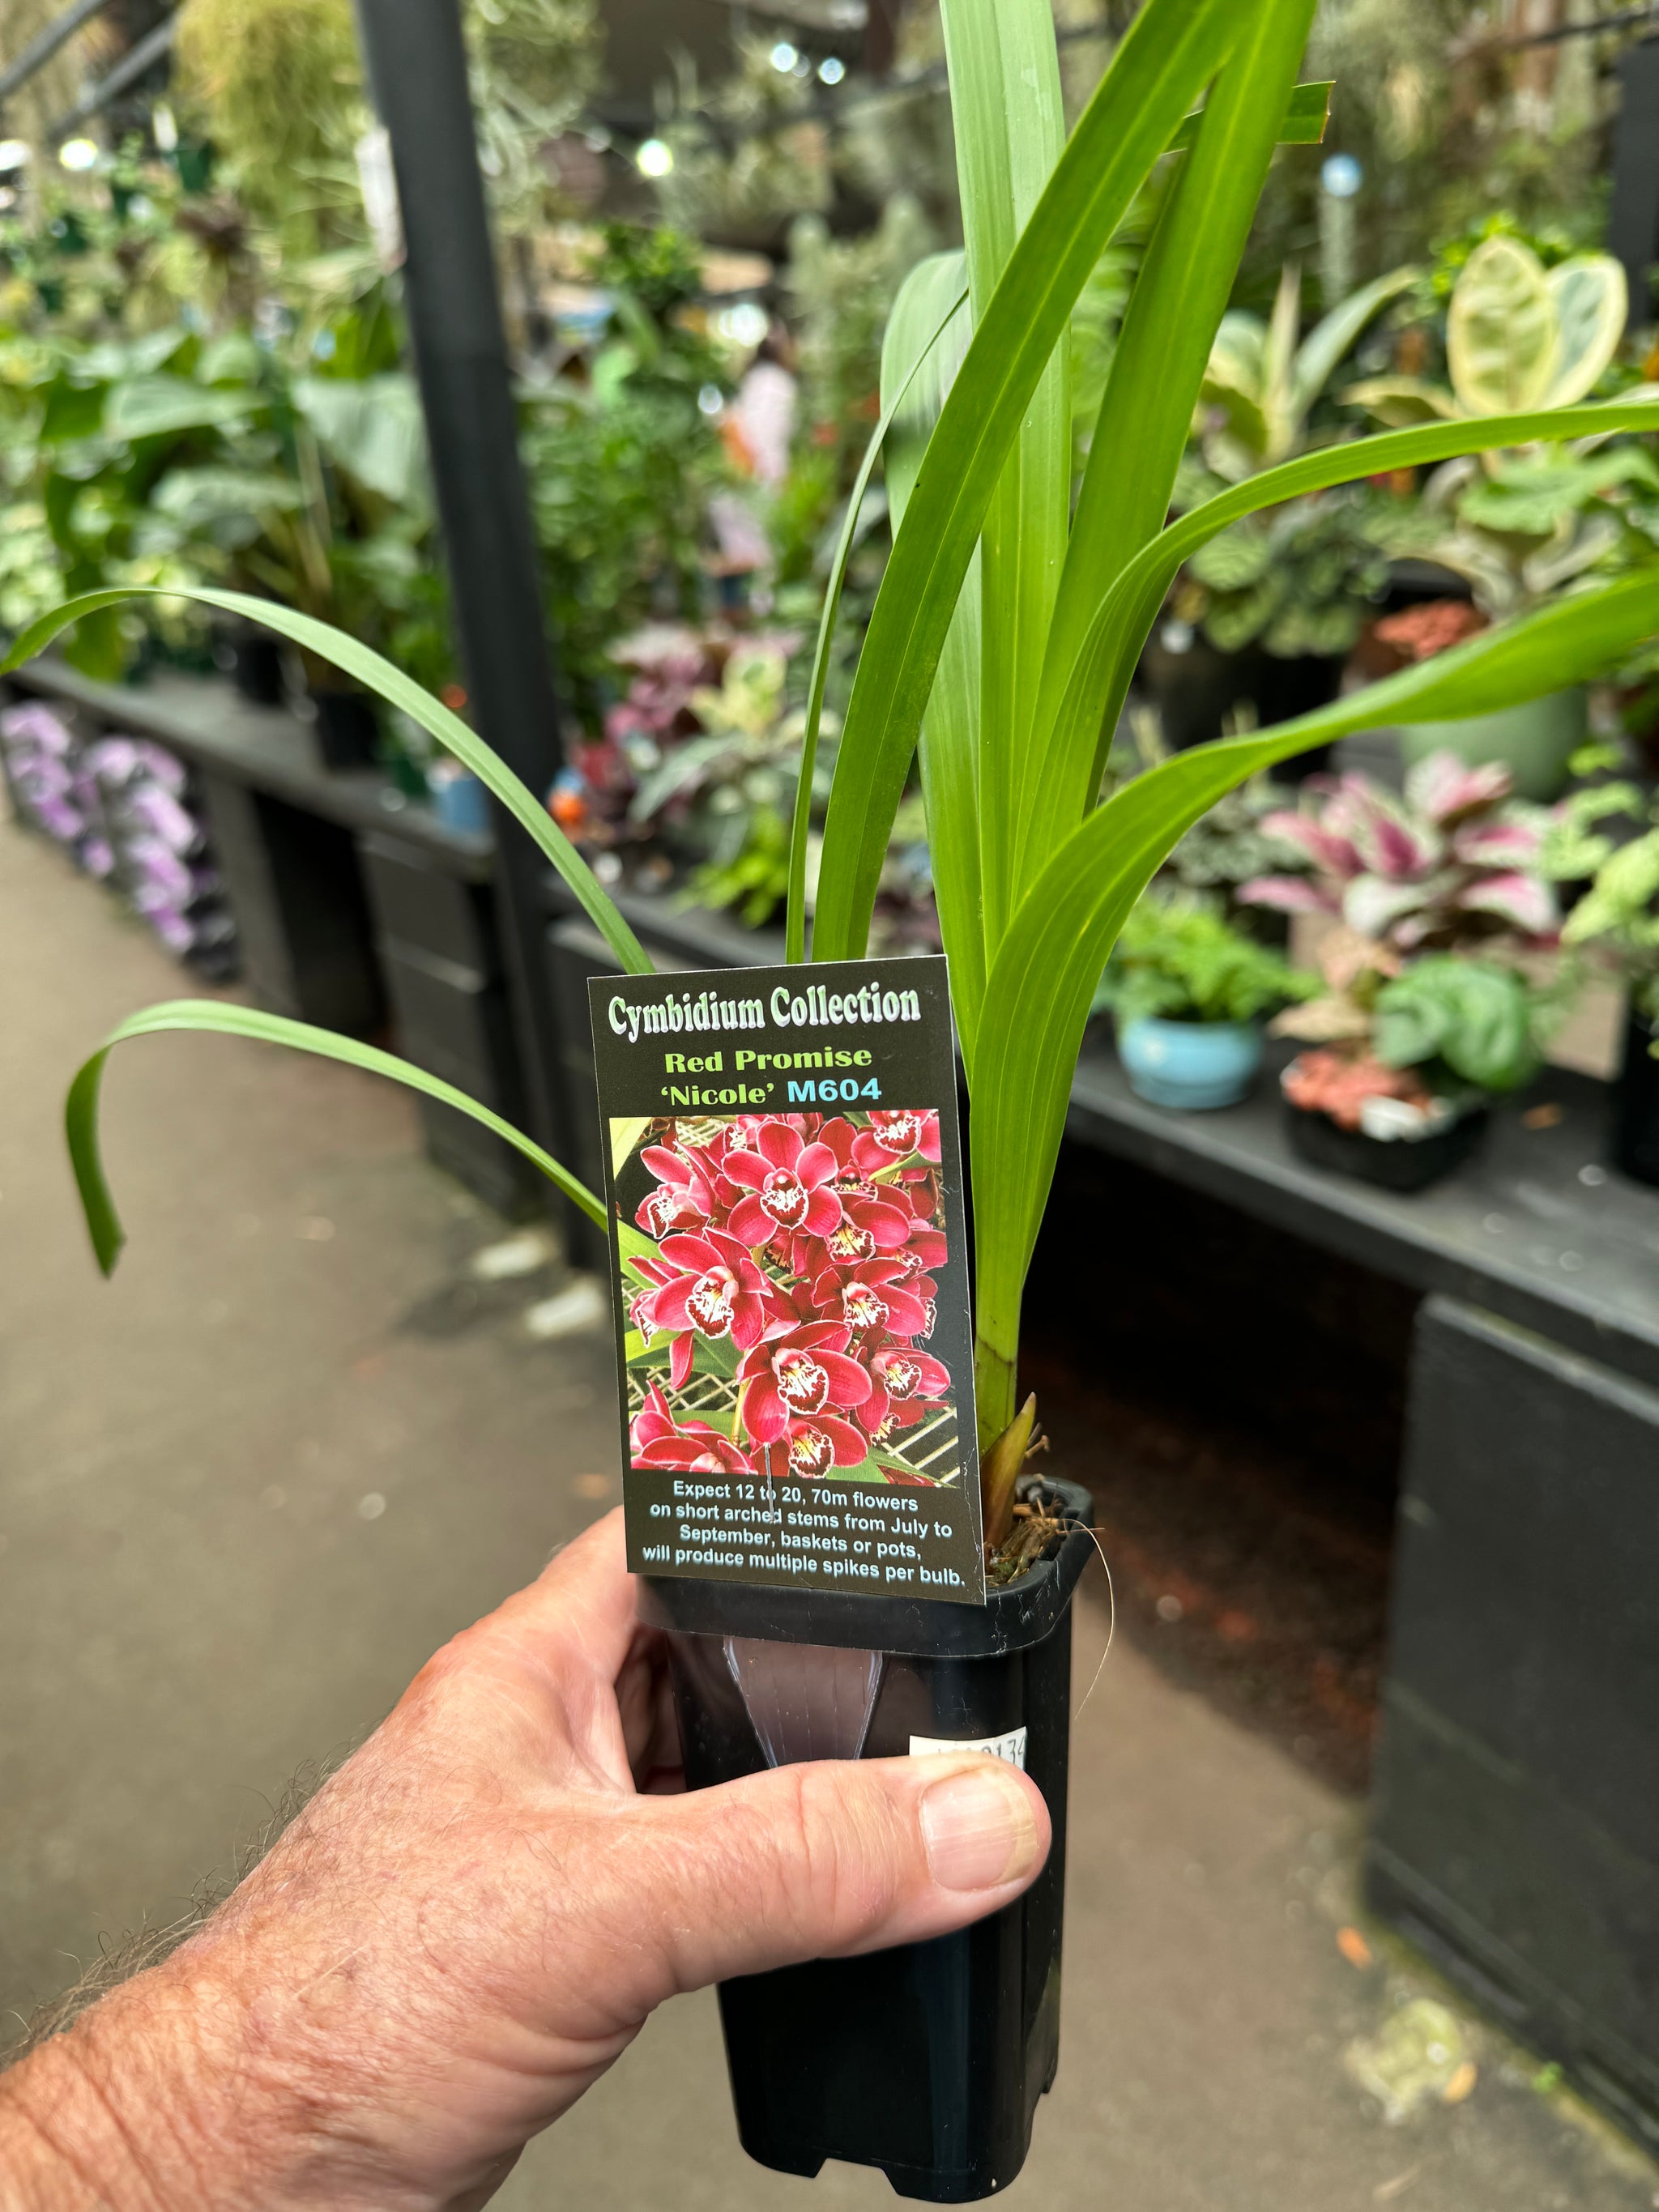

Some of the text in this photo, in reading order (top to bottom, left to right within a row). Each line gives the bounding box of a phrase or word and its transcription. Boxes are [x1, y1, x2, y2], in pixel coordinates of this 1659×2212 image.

[608, 982, 922, 1044] Cymbidium Collection
[665, 1046, 872, 1073] Red Promise
[787, 1078, 882, 1102] M604
[673, 1481, 919, 1512] Expect 12 to 20, 70m flowers
[650, 1504, 953, 1539] on short arched stems from July to
[680, 1524, 922, 1562] September, baskets or pots,
[642, 1545, 966, 1587] will produce multiple spikes per bulb.
